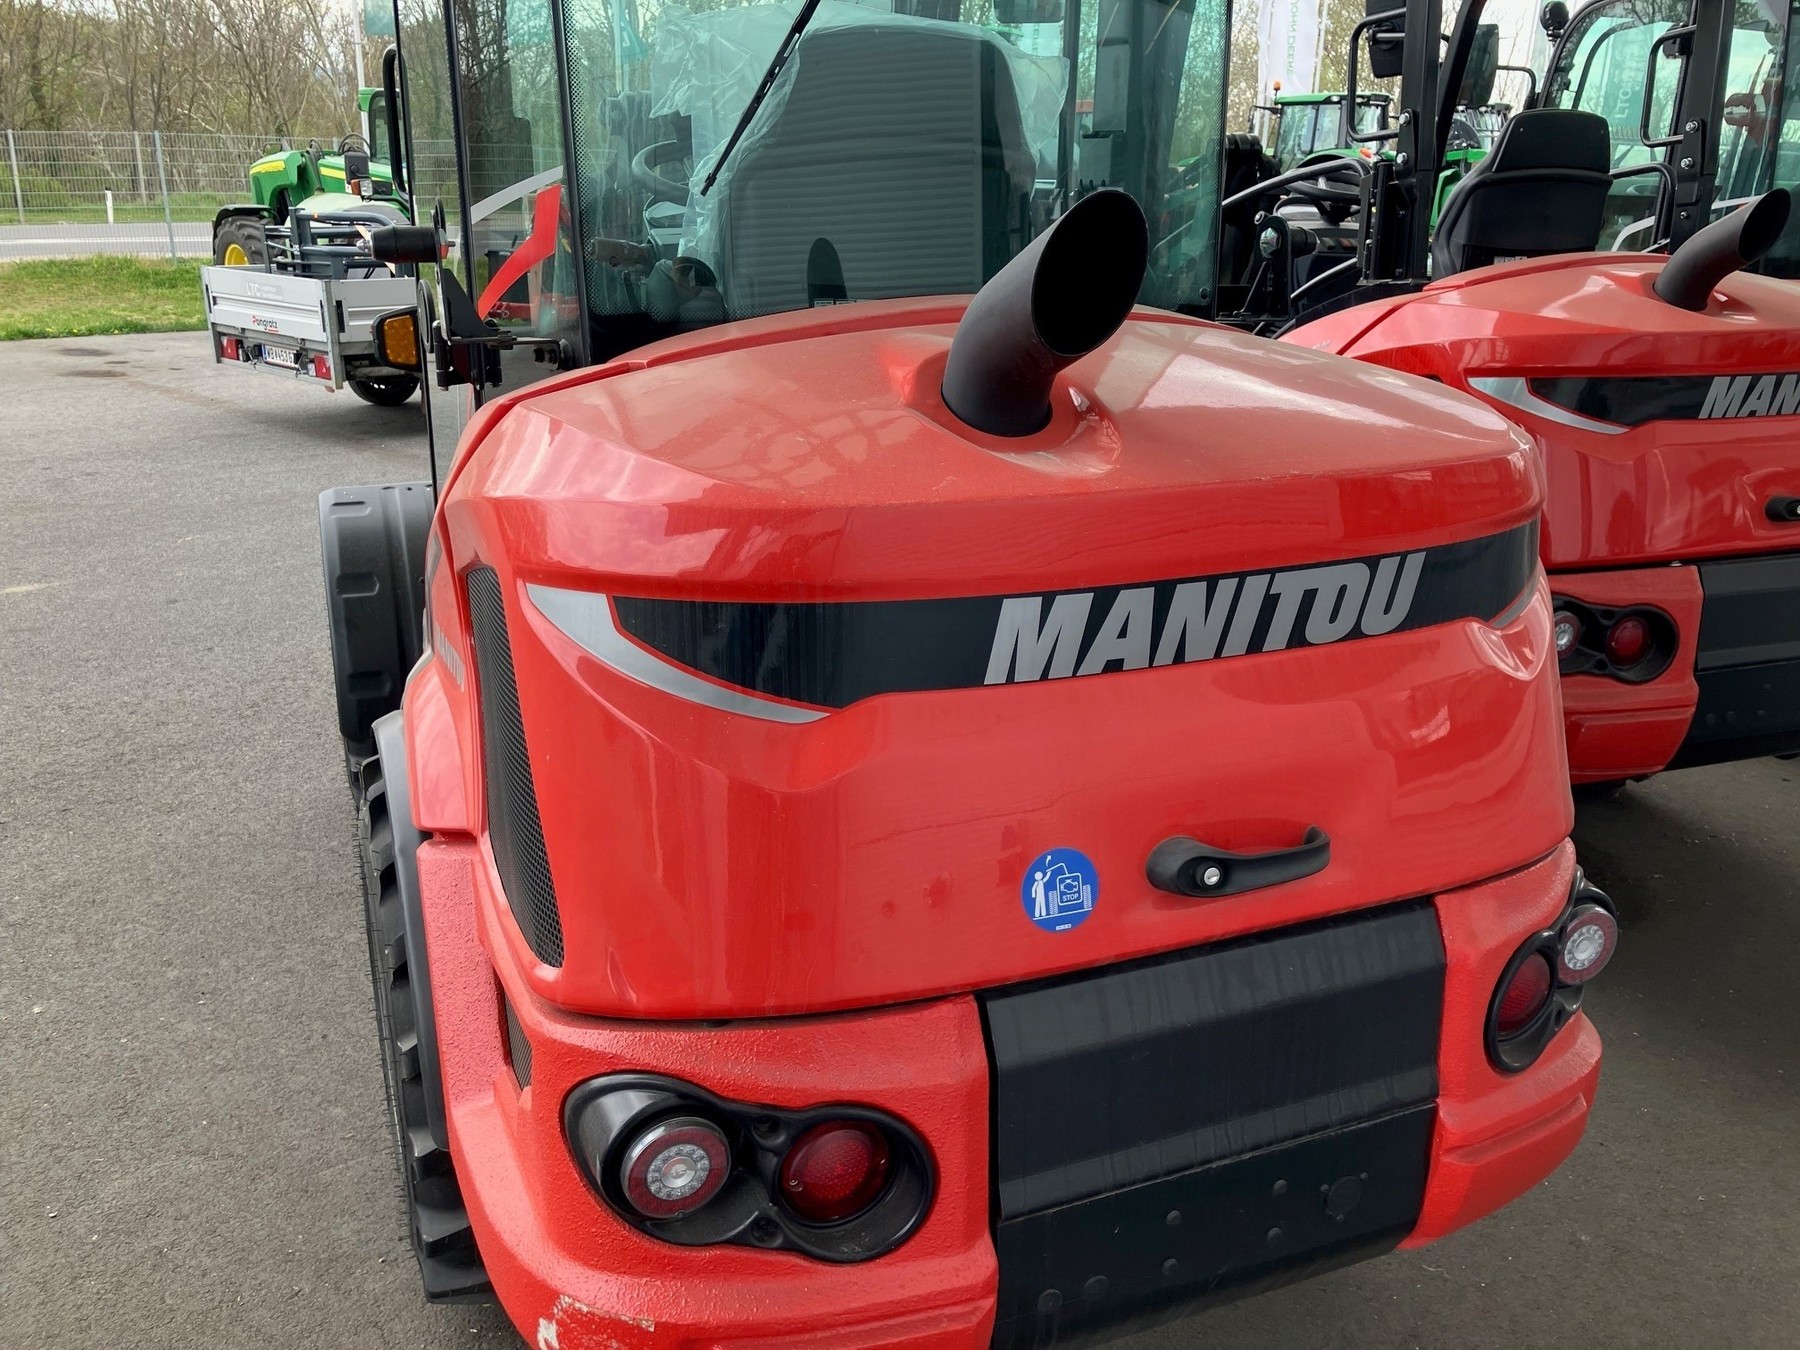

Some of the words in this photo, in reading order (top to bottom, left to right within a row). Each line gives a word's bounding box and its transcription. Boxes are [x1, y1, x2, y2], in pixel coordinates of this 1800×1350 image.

[1614, 88, 1632, 119] LTC
[983, 551, 1427, 685] MANITOU
[1062, 893, 1079, 902] STOP
